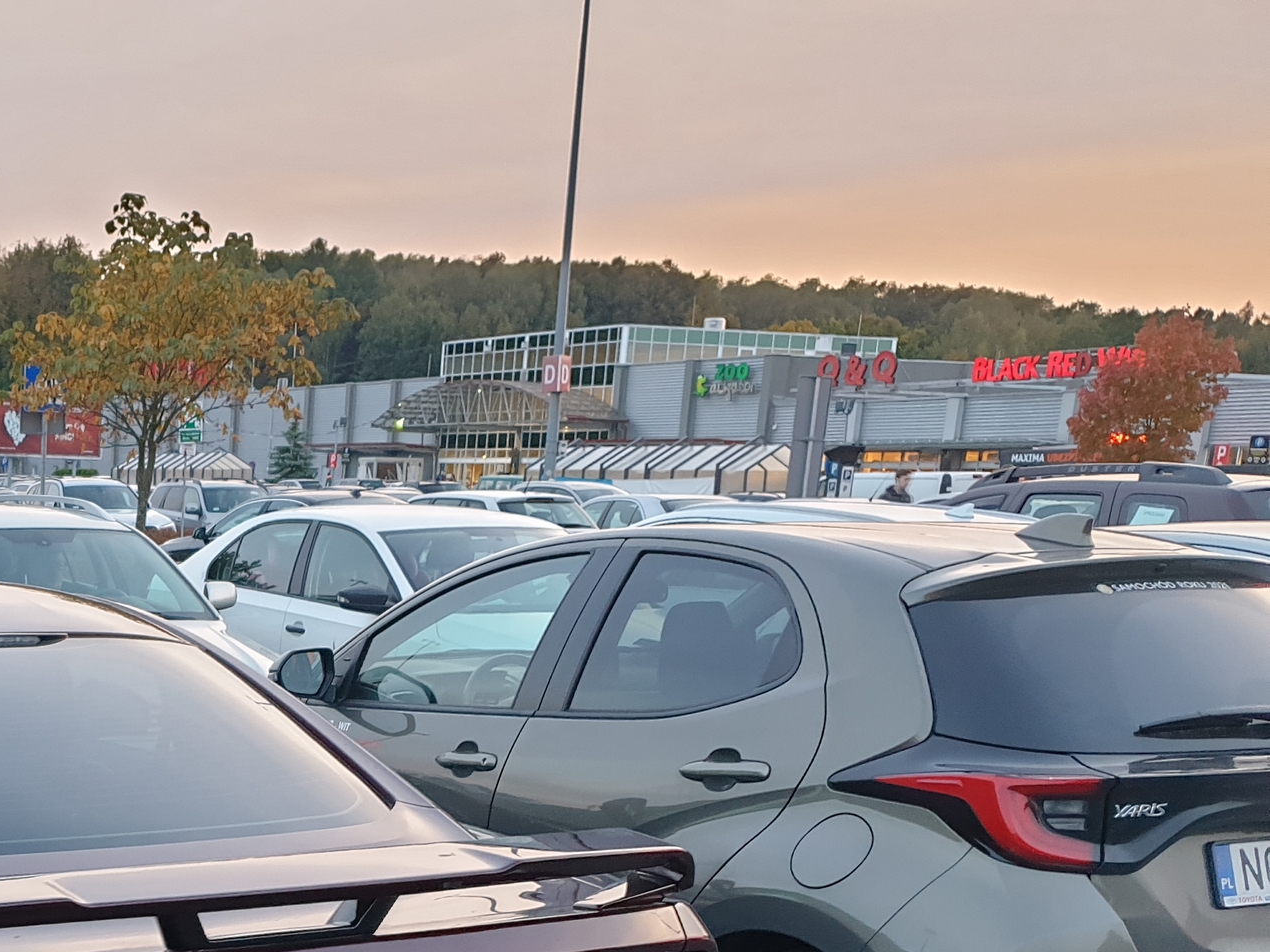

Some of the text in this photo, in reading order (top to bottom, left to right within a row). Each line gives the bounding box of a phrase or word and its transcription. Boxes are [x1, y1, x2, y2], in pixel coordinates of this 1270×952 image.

[544, 364, 556, 385] D
[561, 364, 569, 384] D
[714, 362, 750, 381] ZOO
[817, 350, 898, 387] Q & Q
[972, 356, 1042, 383] BLACK
[1046, 351, 1092, 379] RED
[1011, 453, 1045, 463] MAXIMA
[1217, 445, 1227, 460] P
[1114, 803, 1168, 819] YARIS
[1221, 846, 1270, 891] PL N
